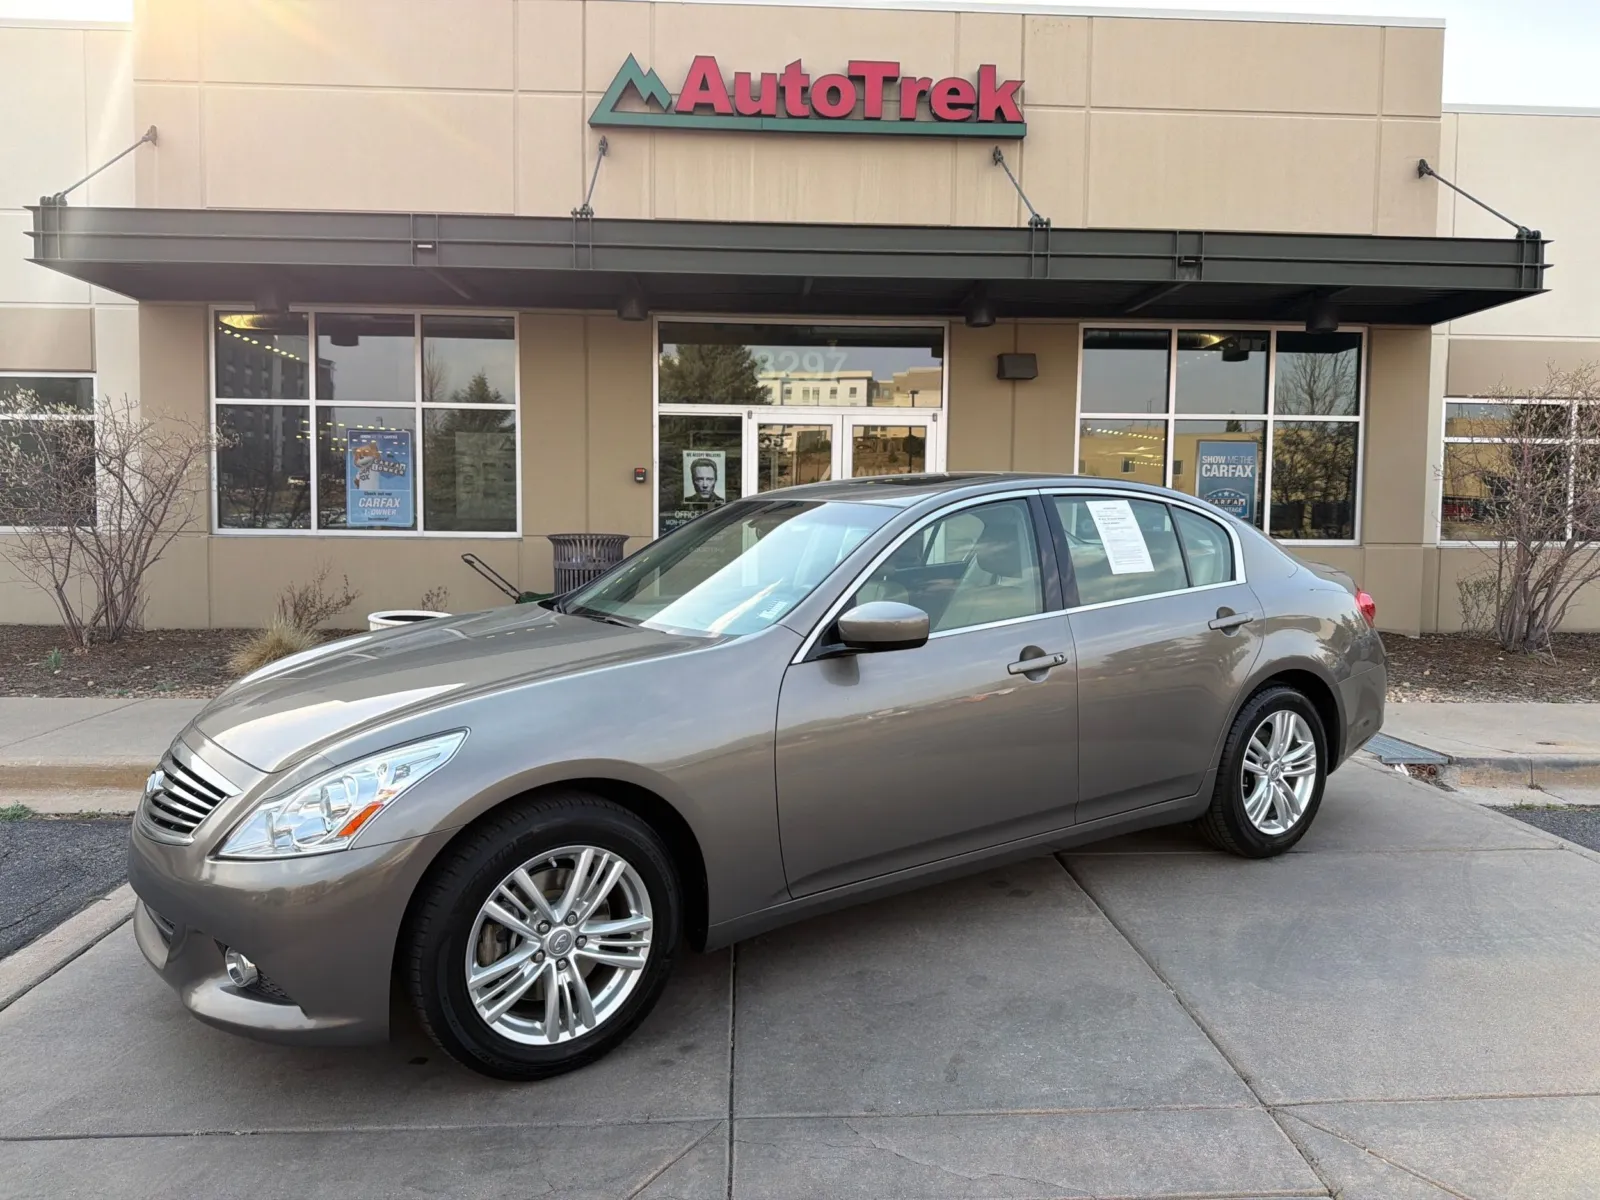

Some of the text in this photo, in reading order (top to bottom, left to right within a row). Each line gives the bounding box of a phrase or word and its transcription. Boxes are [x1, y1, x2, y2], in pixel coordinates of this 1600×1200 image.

[674, 55, 1025, 123] AutoTrek
[1202, 456, 1253, 464] SHOW ME THE
[1202, 465, 1253, 477] CARFAX
[359, 497, 400, 508] CARFAX
[675, 510, 699, 519] OFFICE
